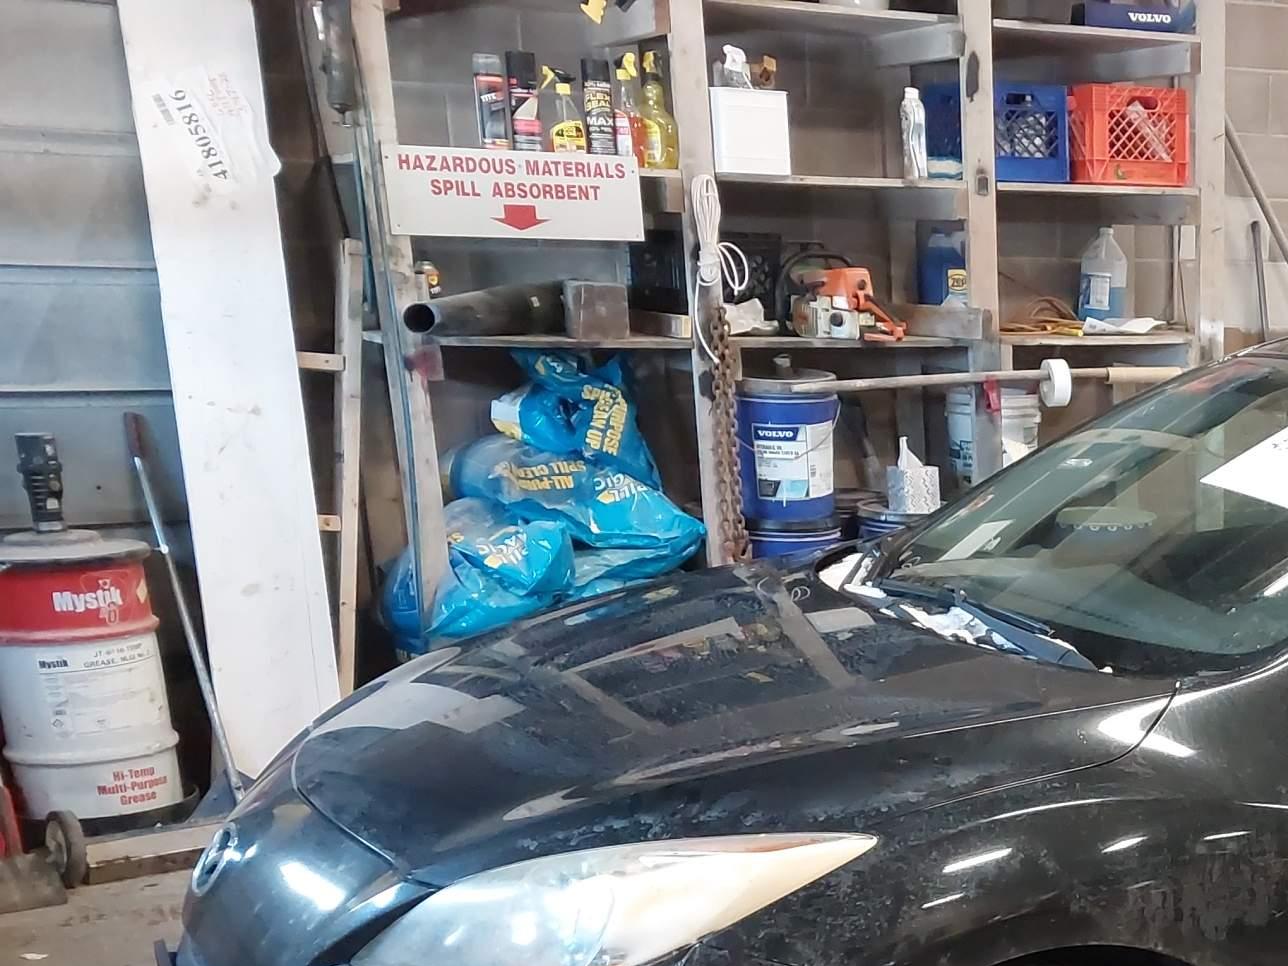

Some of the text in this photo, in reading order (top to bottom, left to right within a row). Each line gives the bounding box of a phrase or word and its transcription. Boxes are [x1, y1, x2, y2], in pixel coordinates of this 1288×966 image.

[1128, 12, 1172, 24] VOLVO
[587, 115, 613, 126] MAX
[169, 89, 229, 181] 41805816
[397, 153, 625, 179] HAZARDOUS MATERIALS
[430, 178, 601, 201] SPILL ABSORBENT
[757, 430, 794, 438] VOLVO
[52, 586, 124, 613] Mystik
[38, 659, 69, 670] Mystik
[112, 766, 155, 782] Hi-Temp
[97, 775, 168, 796] Multi-Purpose
[120, 791, 157, 806] Grease
